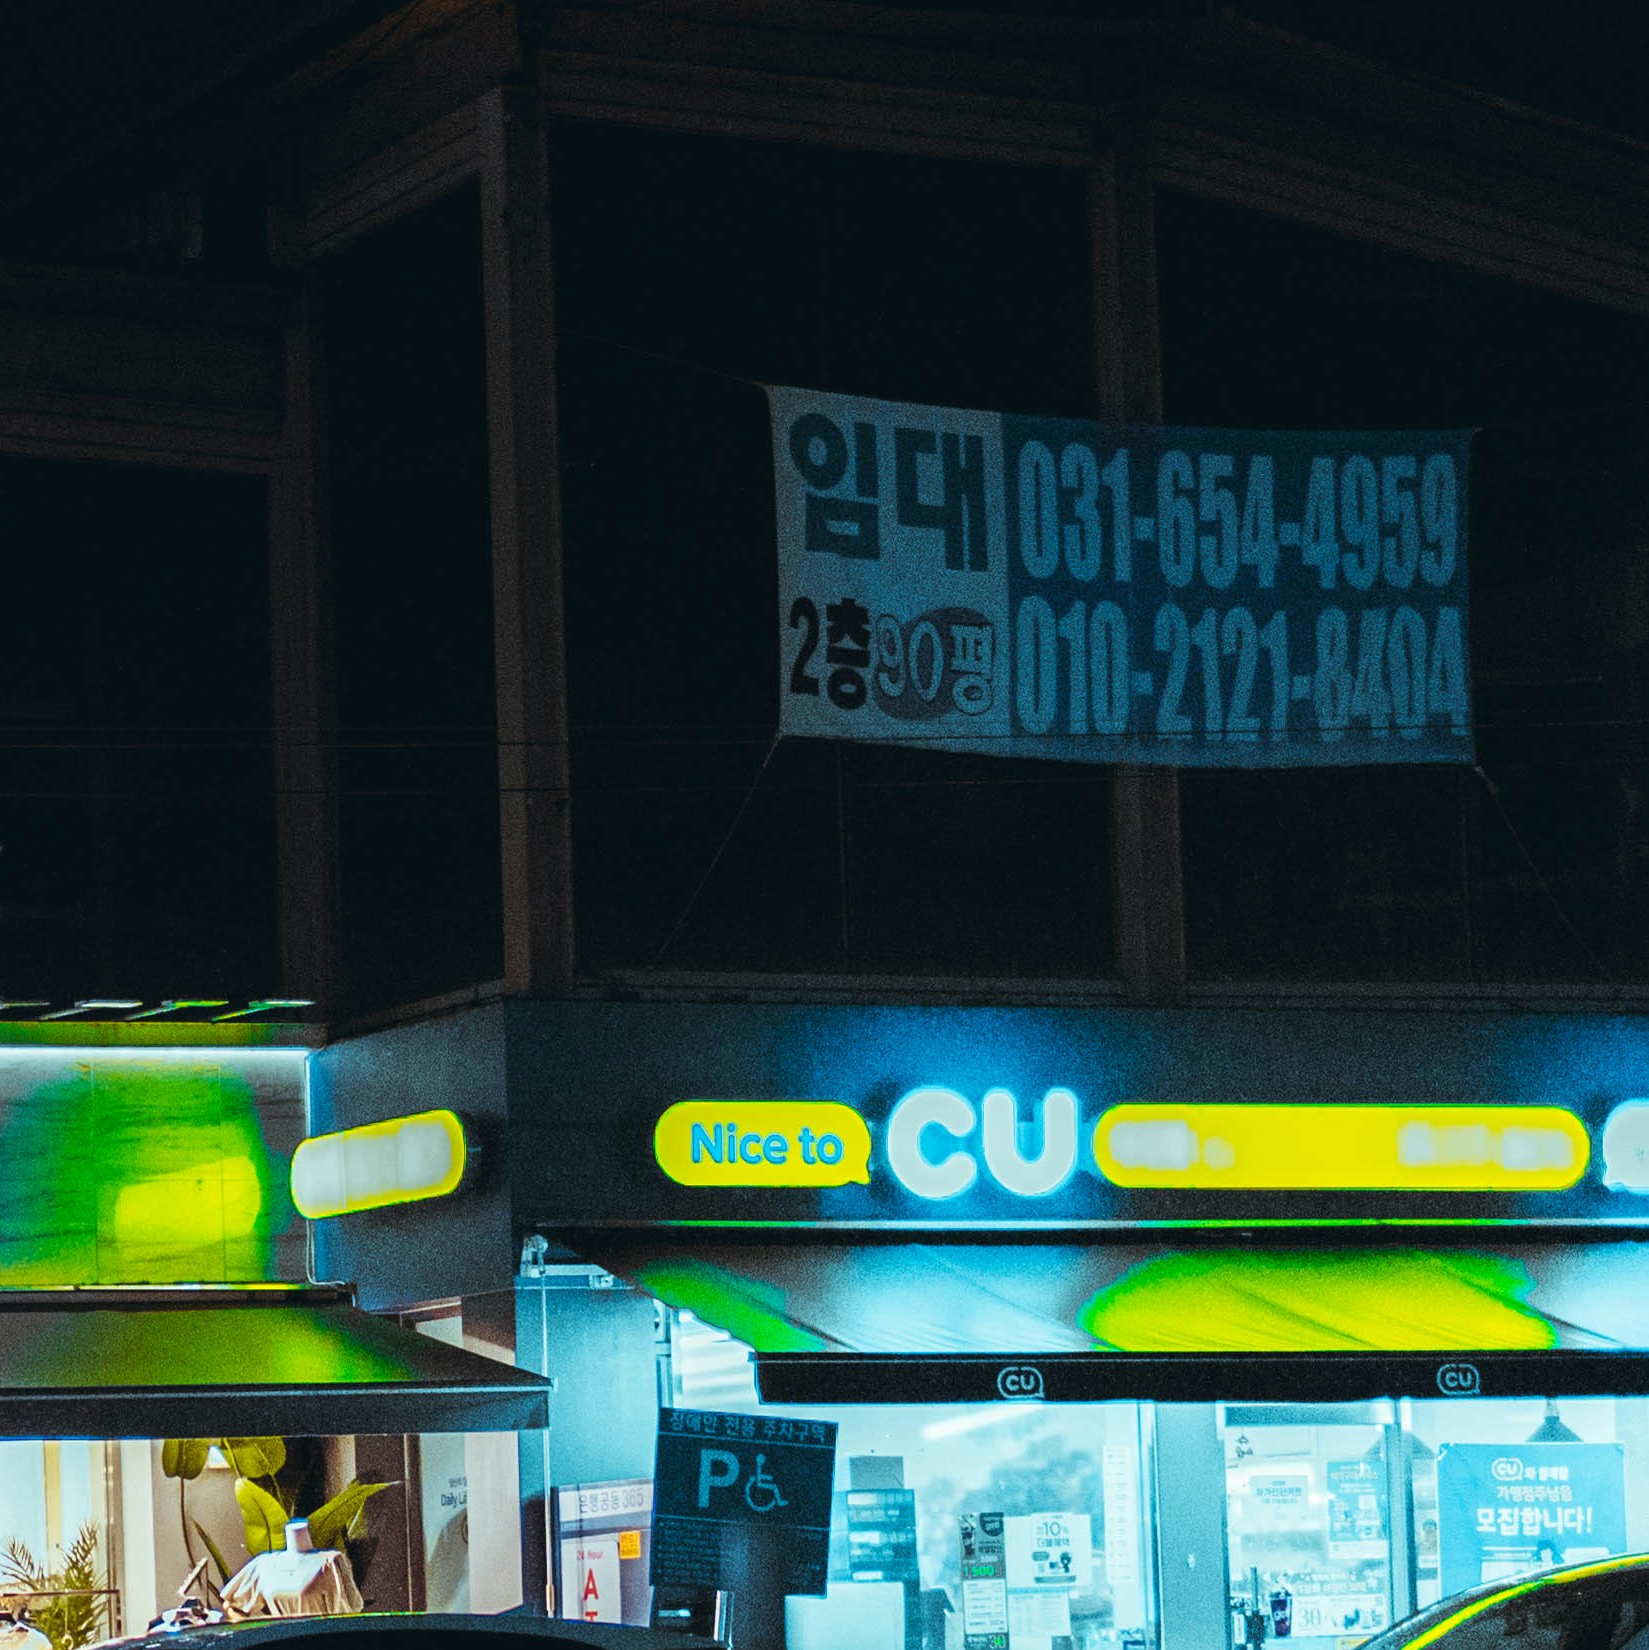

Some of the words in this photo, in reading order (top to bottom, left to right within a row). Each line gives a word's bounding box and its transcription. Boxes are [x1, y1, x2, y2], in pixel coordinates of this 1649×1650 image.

[788, 412, 990, 573] 임대
[1016, 439, 1461, 591] 031-654-4959
[788, 597, 871, 712] 2층
[871, 612, 995, 717] 90평
[1015, 595, 1469, 743] 010-2121-8404
[690, 1122, 789, 1165] Nice
[797, 1126, 845, 1165] to
[887, 1086, 1079, 1200] CU
[669, 1412, 718, 1434] 장애인
[724, 1415, 756, 1437] 전용
[762, 1419, 826, 1442] 주차구역
[697, 1448, 741, 1509] P
[1476, 1505, 1593, 1537] 모집합니다!
